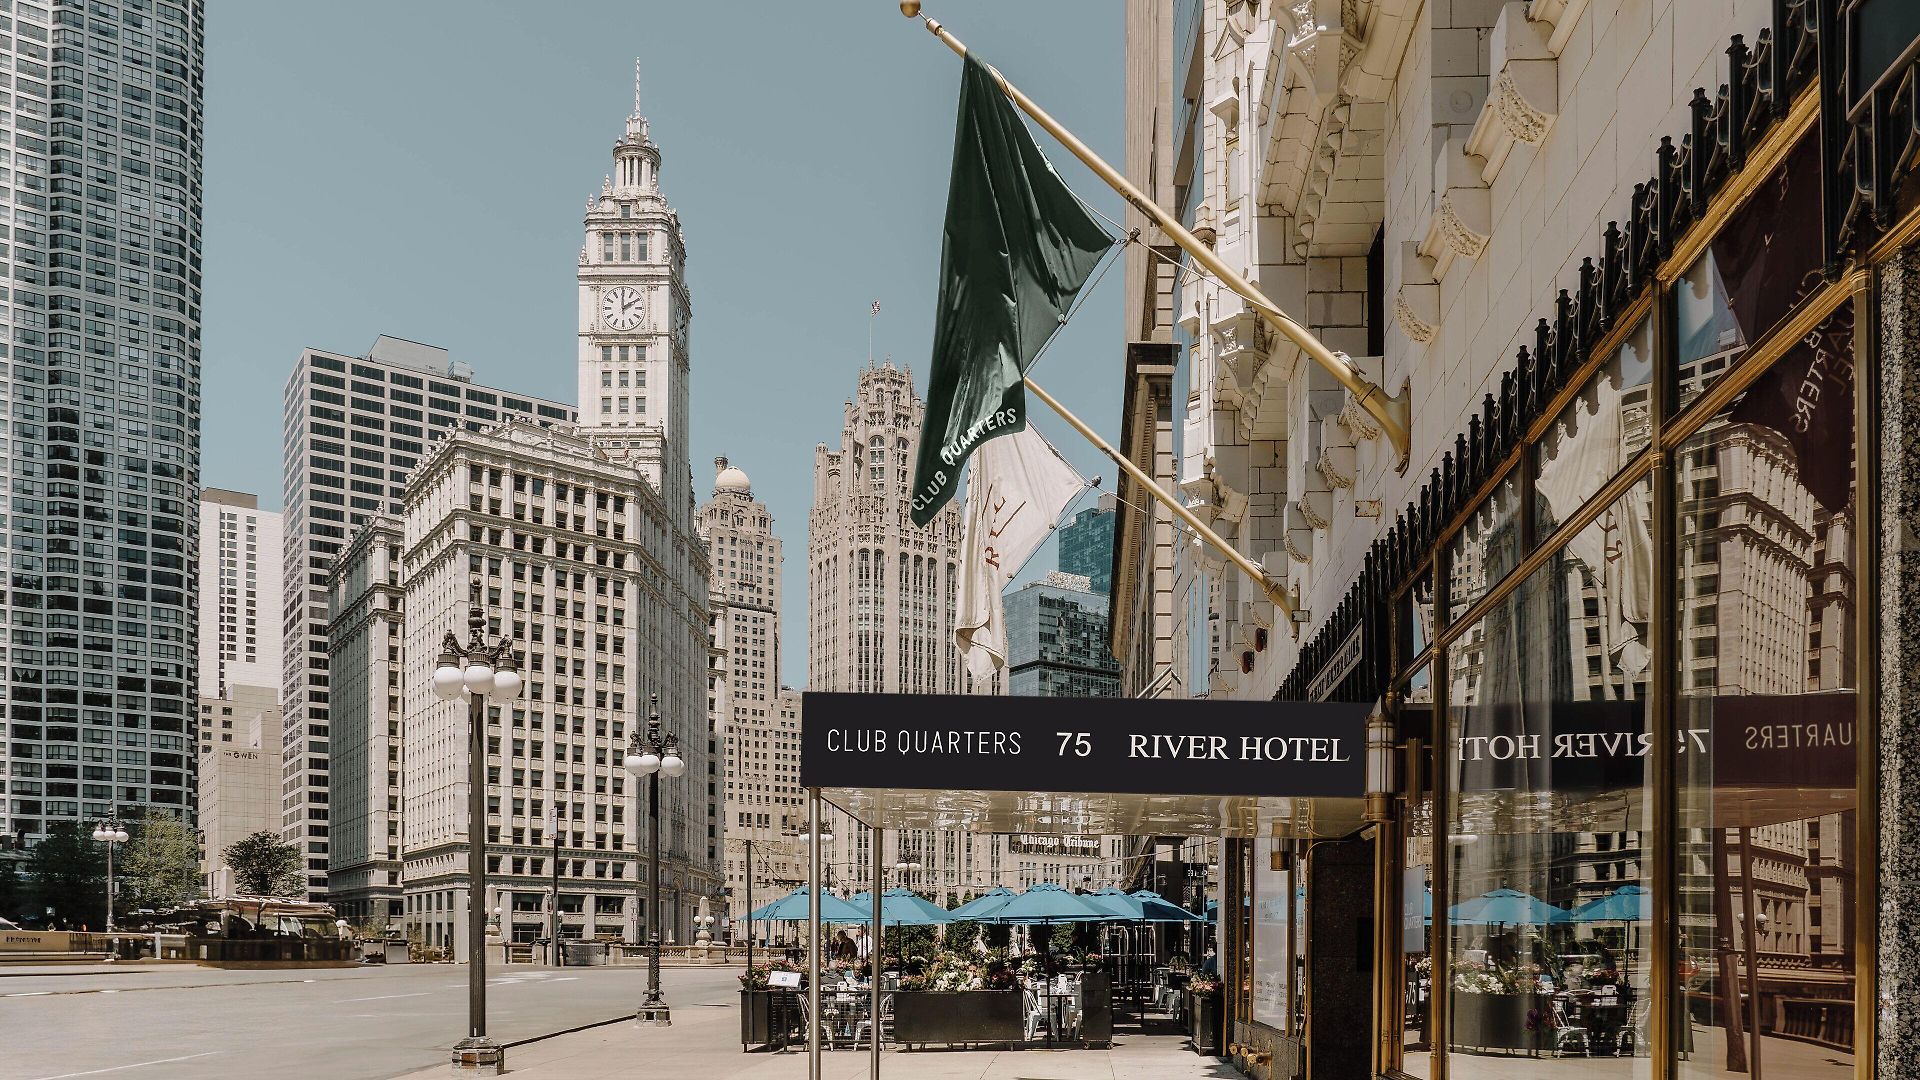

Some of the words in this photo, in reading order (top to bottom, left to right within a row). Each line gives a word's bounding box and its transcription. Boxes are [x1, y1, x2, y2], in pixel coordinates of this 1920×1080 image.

[911, 470, 947, 511] CLUB
[940, 408, 1017, 466] QUARTERS
[233, 751, 258, 760] GWEN
[827, 728, 887, 753] CLUB
[897, 729, 1022, 756] QUARTERS
[1056, 731, 1092, 757] 75
[1128, 734, 1231, 760] RIVER
[1238, 736, 1351, 763] HOTEL
[1019, 834, 1060, 848] Chicago
[1062, 834, 1100, 849] Tribune
